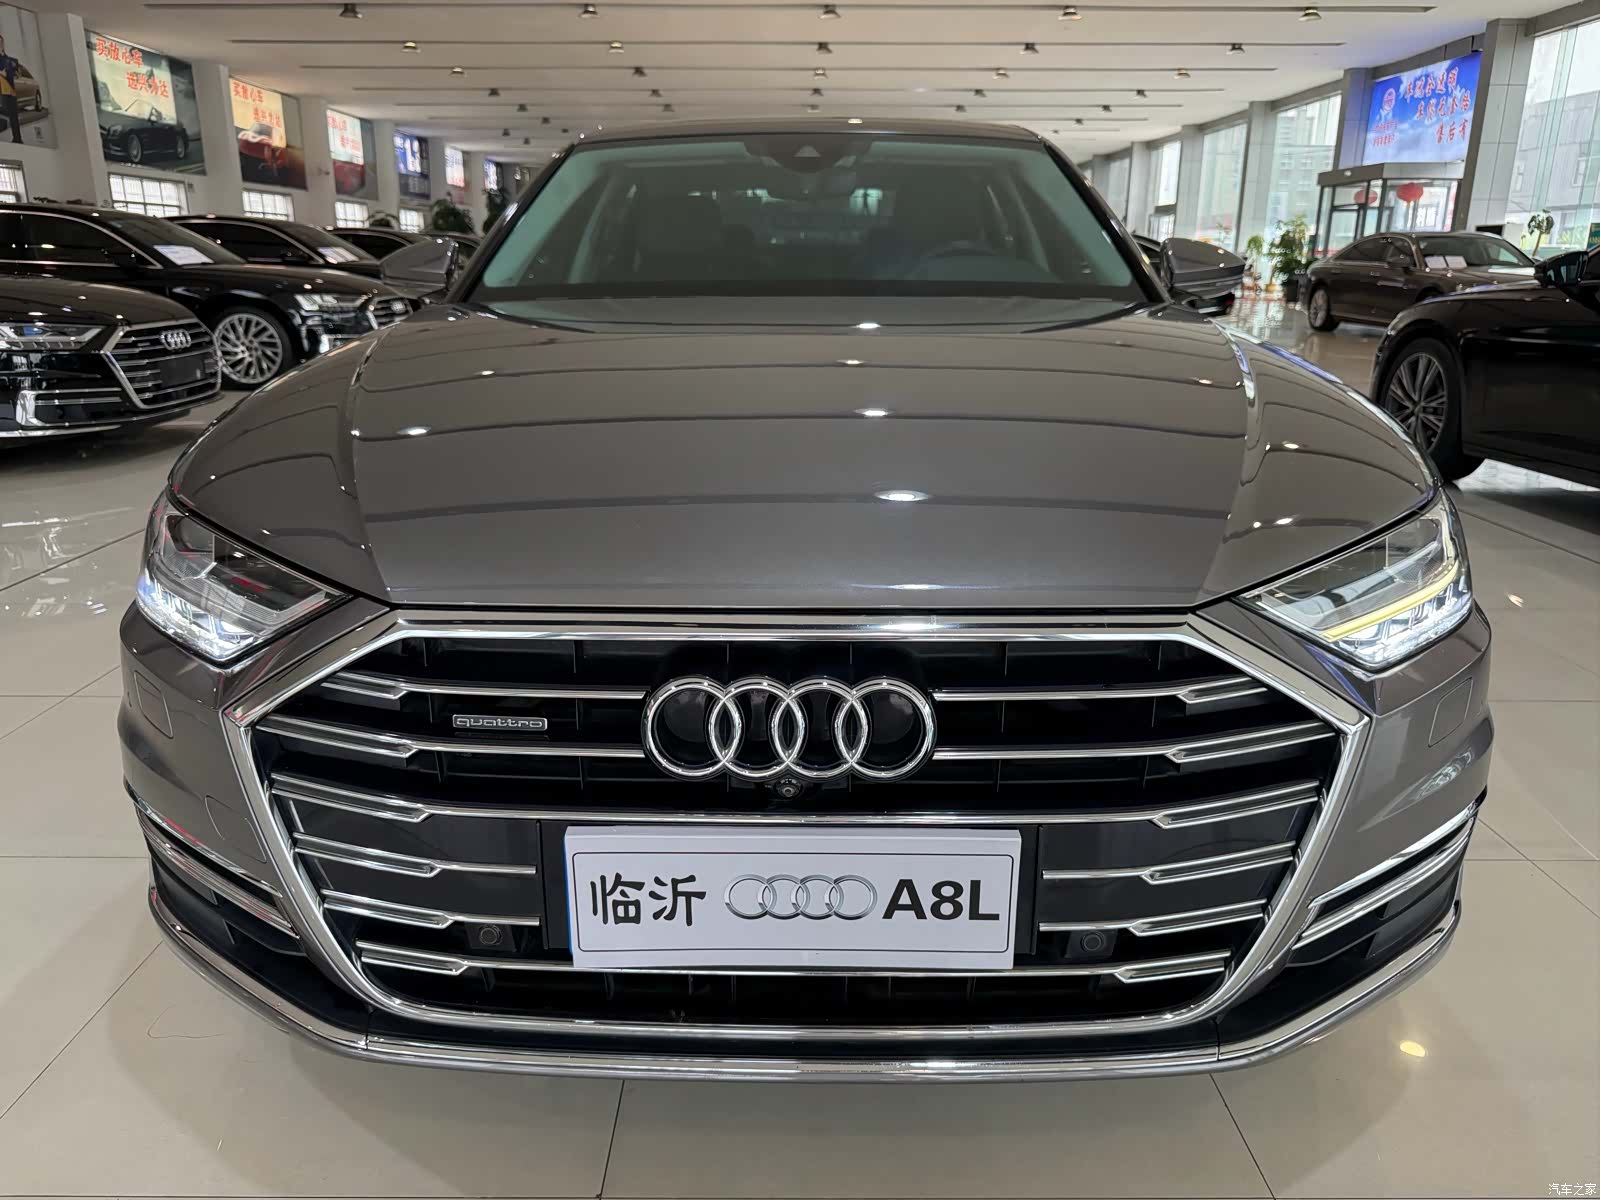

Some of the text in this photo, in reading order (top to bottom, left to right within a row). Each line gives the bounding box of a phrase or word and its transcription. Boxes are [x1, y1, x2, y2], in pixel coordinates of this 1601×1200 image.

[456, 718, 543, 728] quattro
[590, 873, 1000, 927] 临沂 A8L
